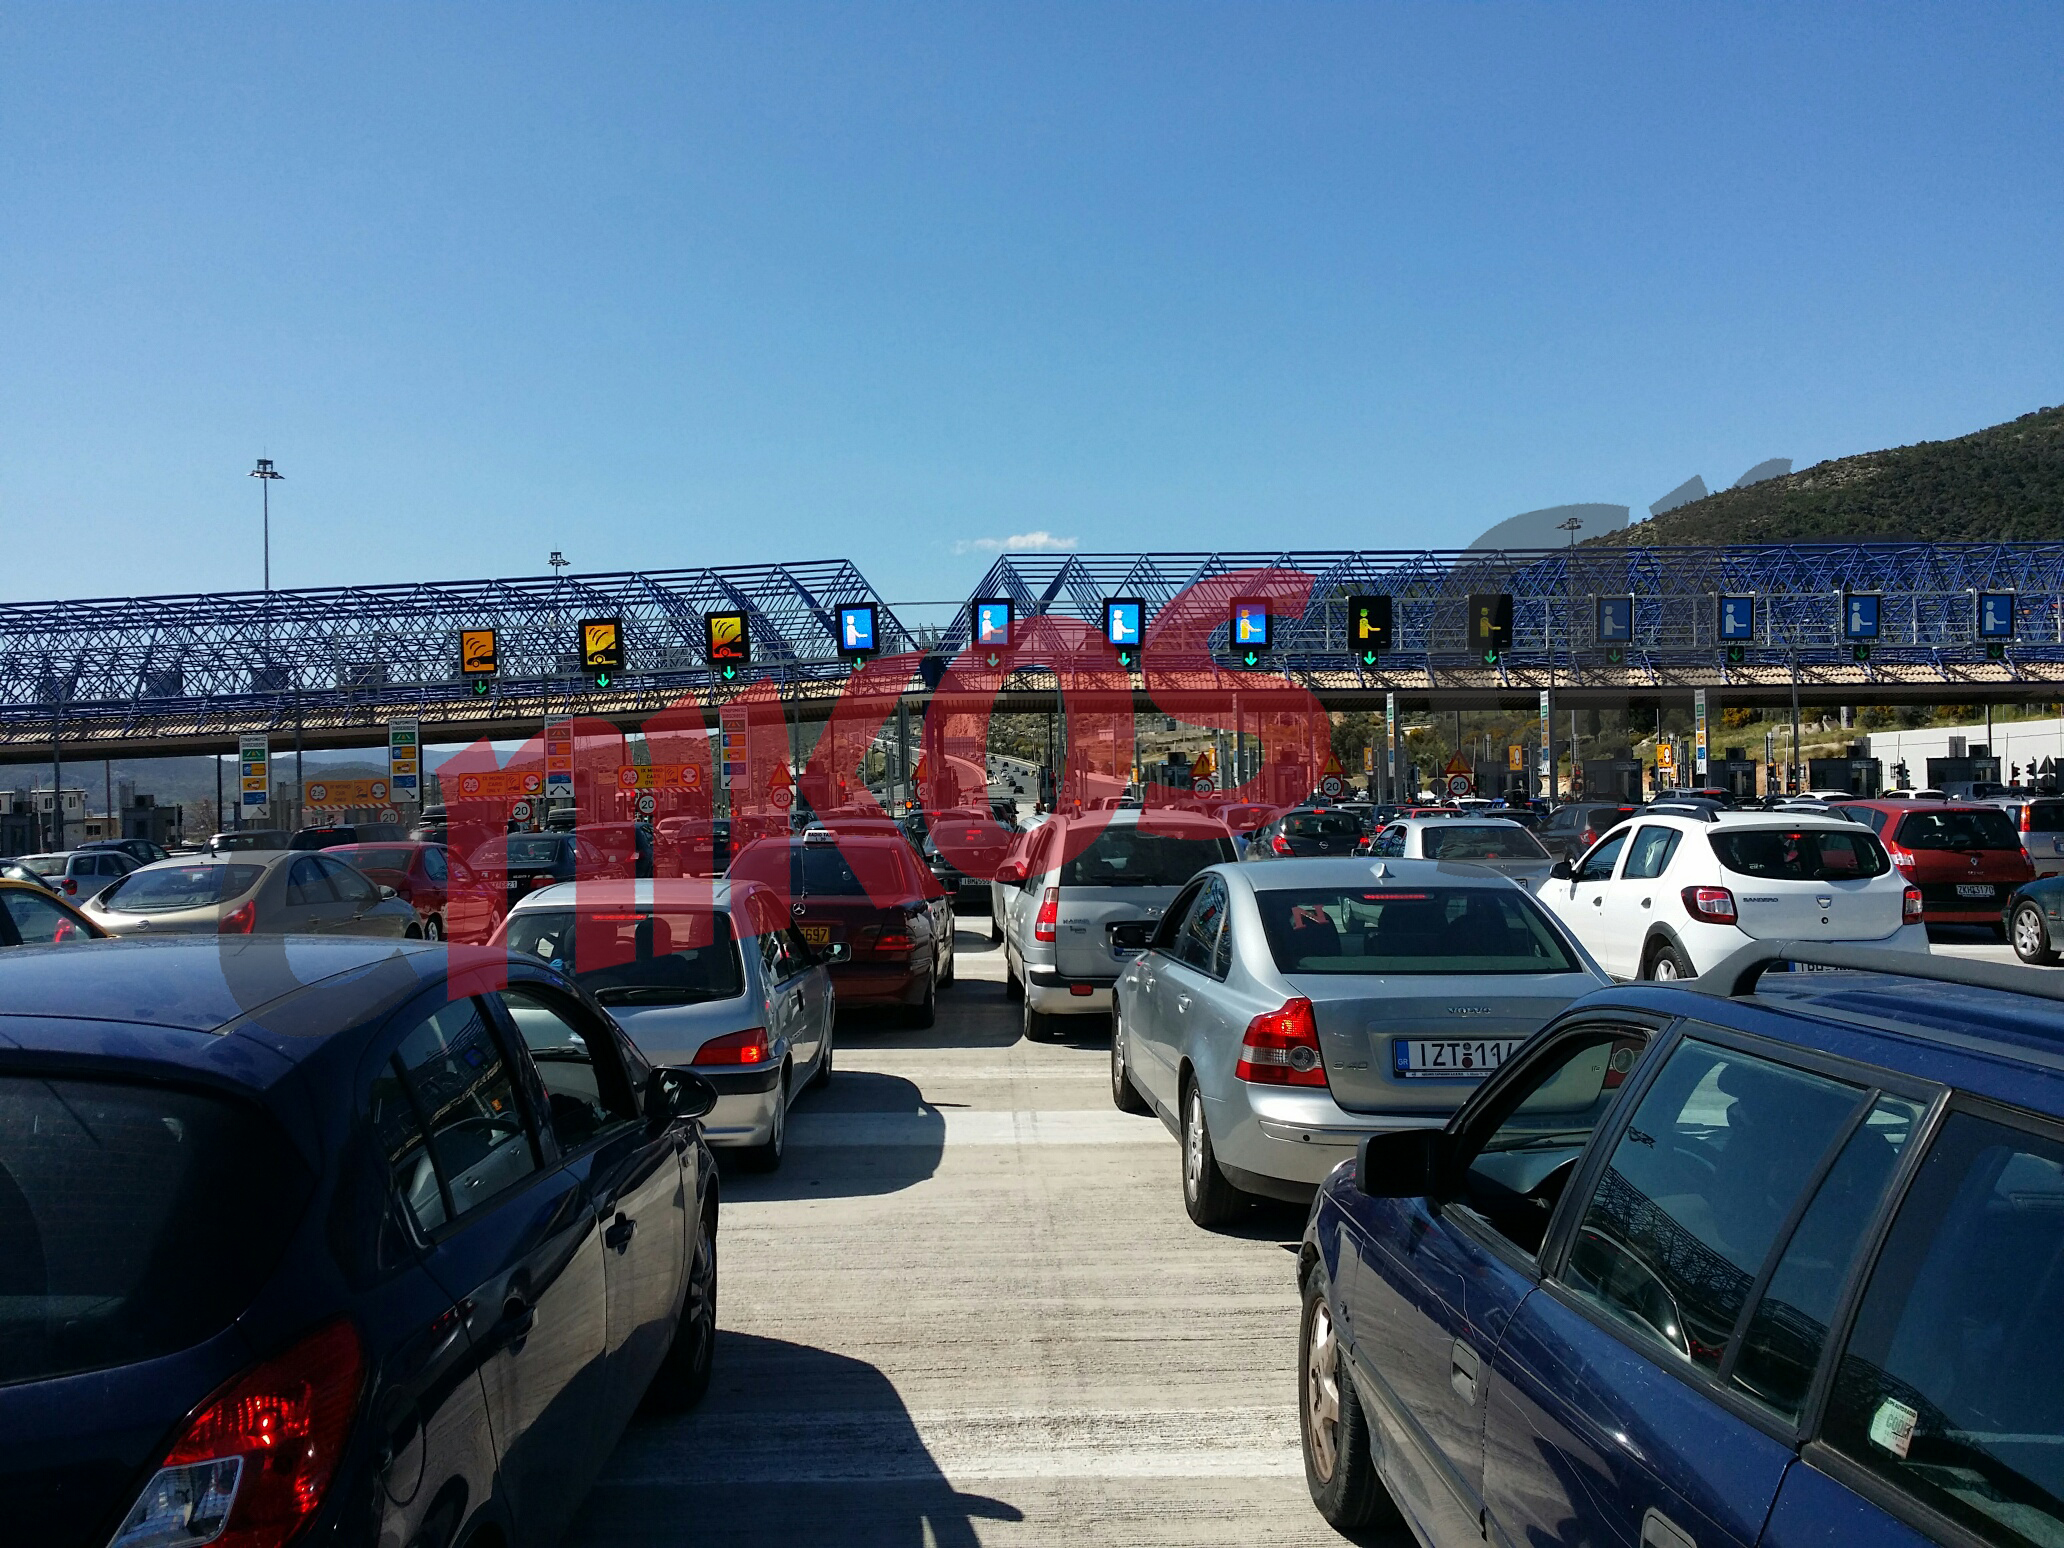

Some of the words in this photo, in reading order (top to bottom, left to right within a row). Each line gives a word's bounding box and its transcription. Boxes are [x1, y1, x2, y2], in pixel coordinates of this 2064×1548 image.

[1196, 783, 1210, 793] 20
[1325, 782, 1339, 792] 20
[1453, 781, 1467, 791] 20
[776, 792, 789, 802] 20
[641, 799, 655, 810] 20
[515, 806, 529, 816] 20
[382, 812, 397, 823] 20
[1447, 1006, 1491, 1014] VOLVO
[1397, 1058, 1409, 1066] GR
